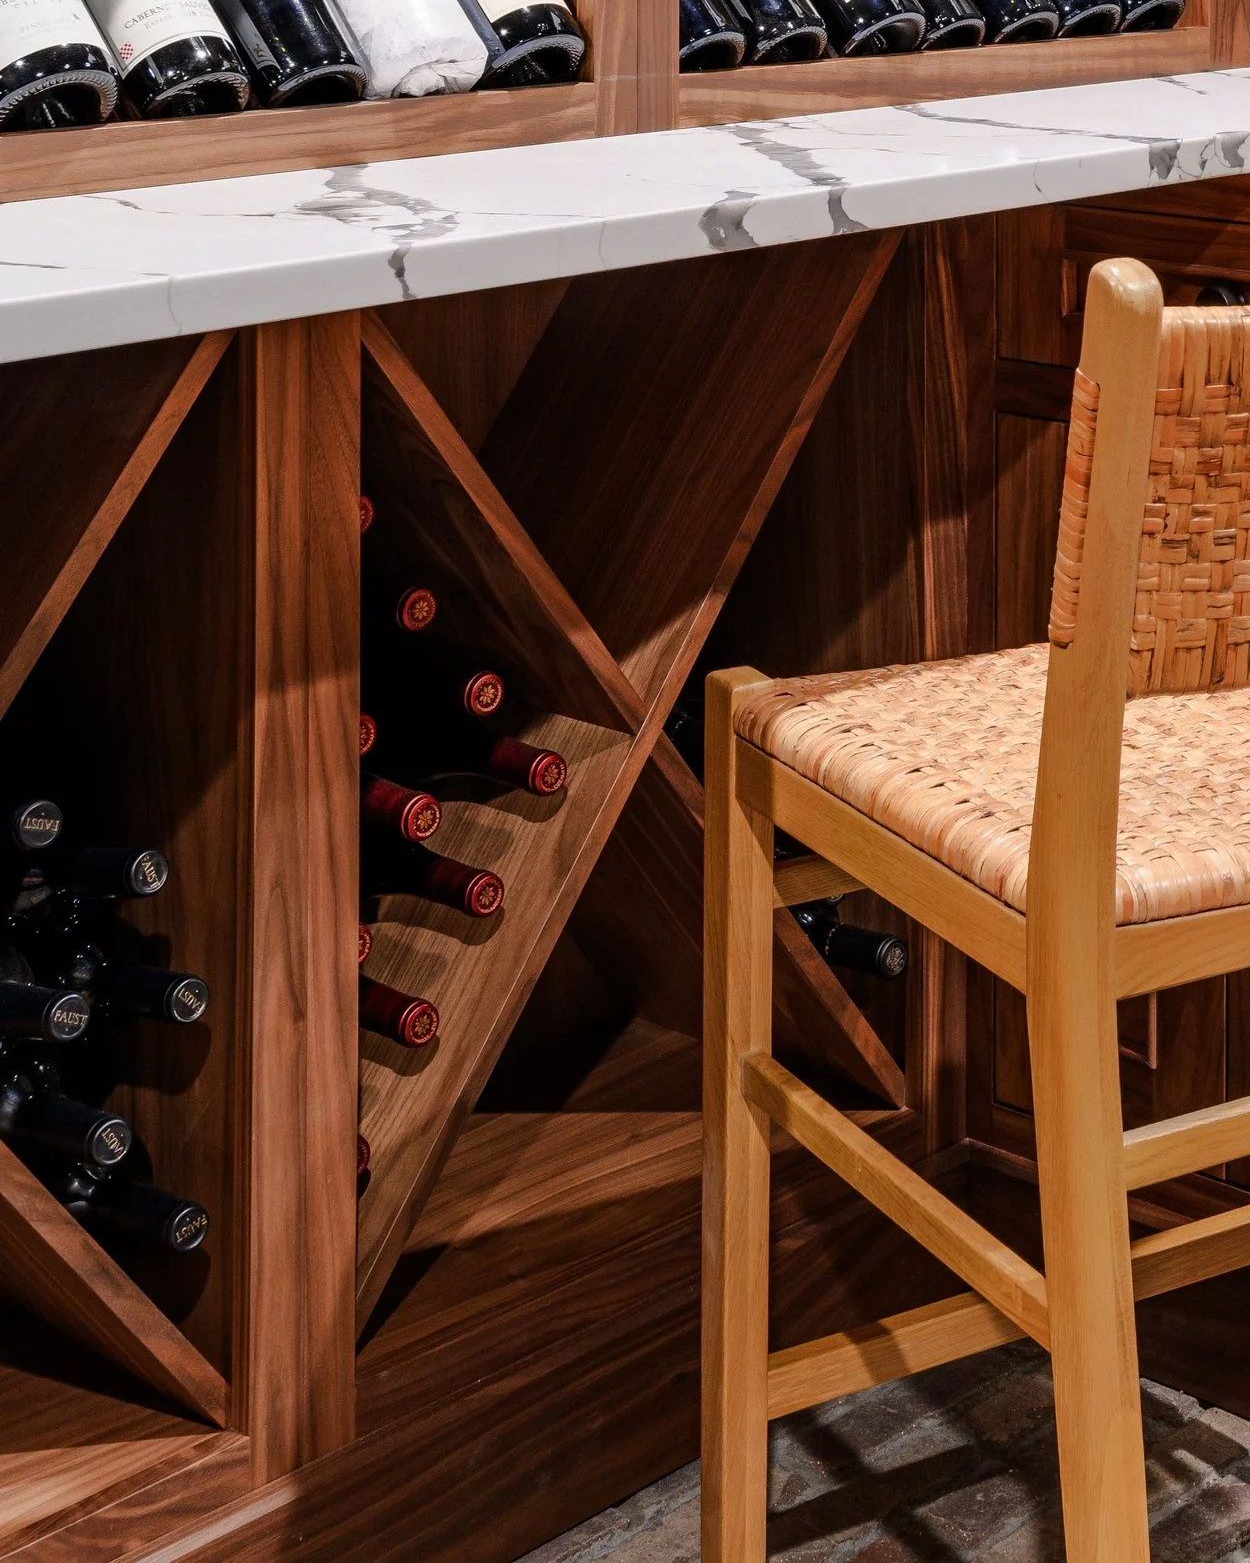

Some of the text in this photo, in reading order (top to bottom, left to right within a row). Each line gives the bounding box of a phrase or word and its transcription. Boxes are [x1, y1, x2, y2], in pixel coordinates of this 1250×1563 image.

[24, 817, 60, 832] FAUST
[54, 1010, 88, 1026] FAUST
[175, 1213, 208, 1244] FAUST
